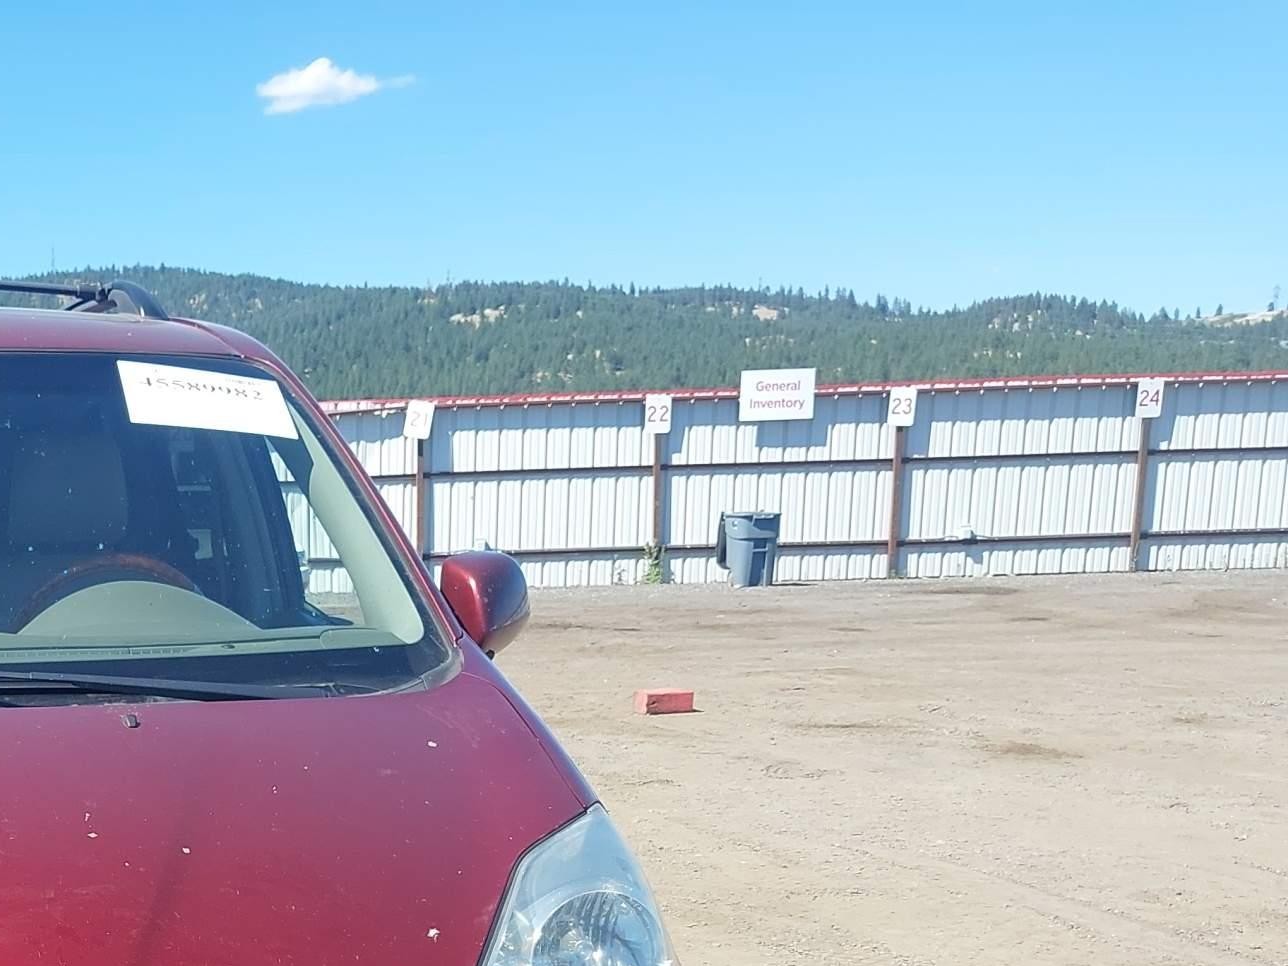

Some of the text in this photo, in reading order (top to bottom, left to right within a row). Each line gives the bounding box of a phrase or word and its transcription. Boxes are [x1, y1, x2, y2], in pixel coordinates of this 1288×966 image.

[755, 380, 802, 392] General
[749, 397, 805, 411] Inventory
[892, 397, 913, 415] 23
[1139, 389, 1161, 406] 24
[410, 411, 428, 428] 21
[647, 405, 670, 423] 22
